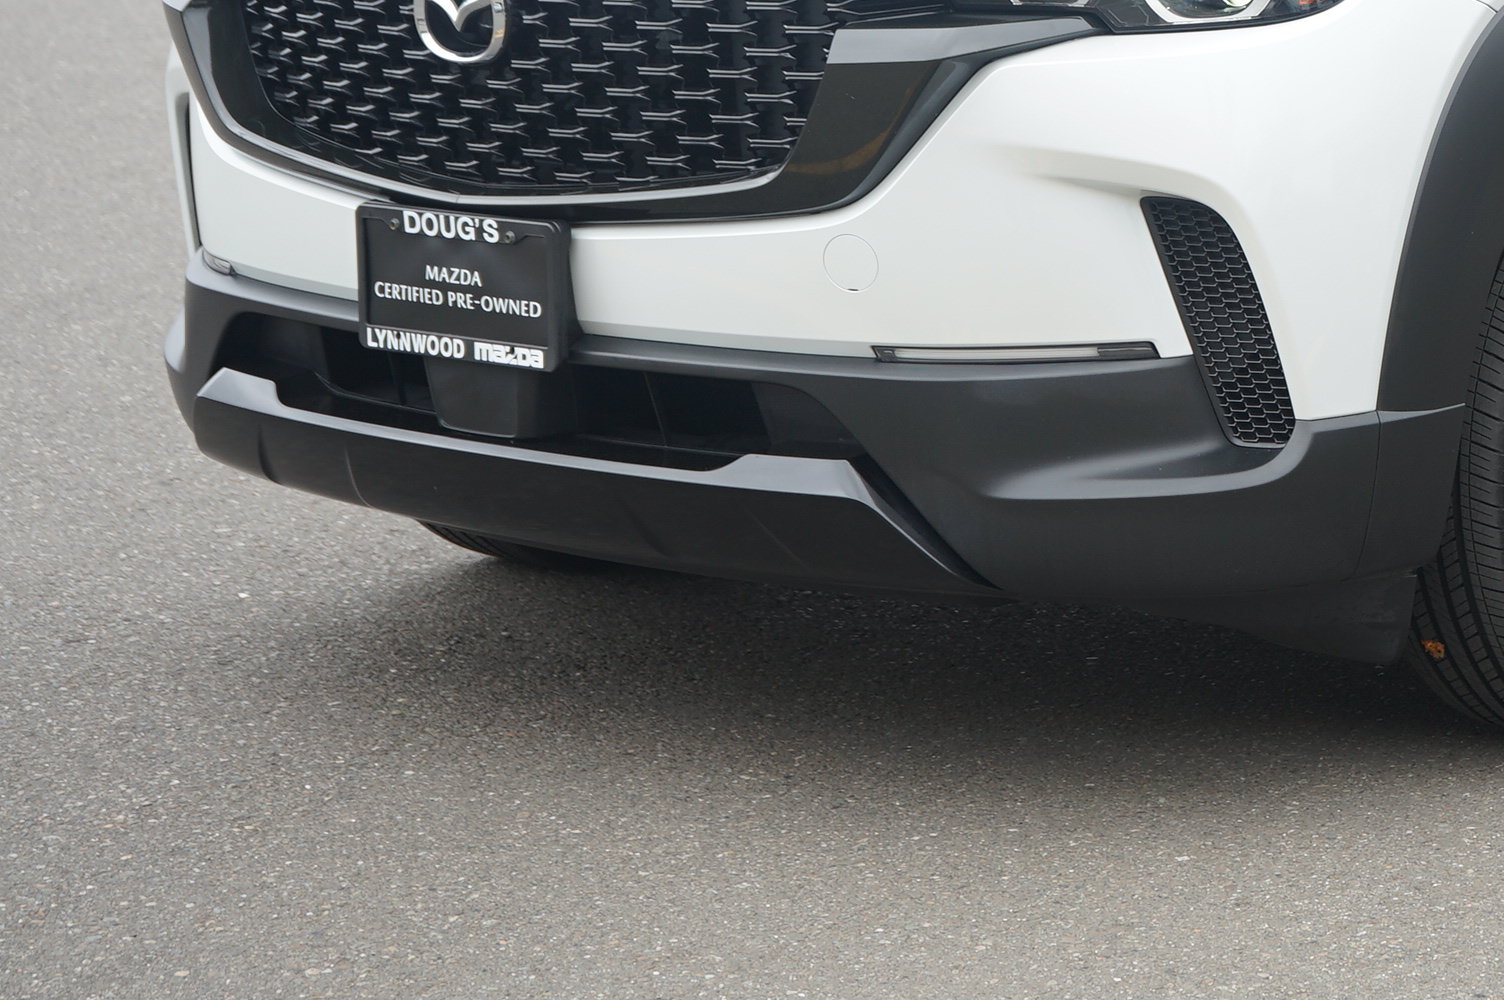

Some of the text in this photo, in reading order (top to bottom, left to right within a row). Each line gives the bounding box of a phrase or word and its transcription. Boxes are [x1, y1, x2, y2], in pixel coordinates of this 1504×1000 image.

[403, 210, 499, 243] DOUG'S
[425, 265, 482, 287] MAZDA
[374, 281, 542, 318] CERTIFIED PRE-OWNED
[367, 327, 465, 359] LYNNWOOD
